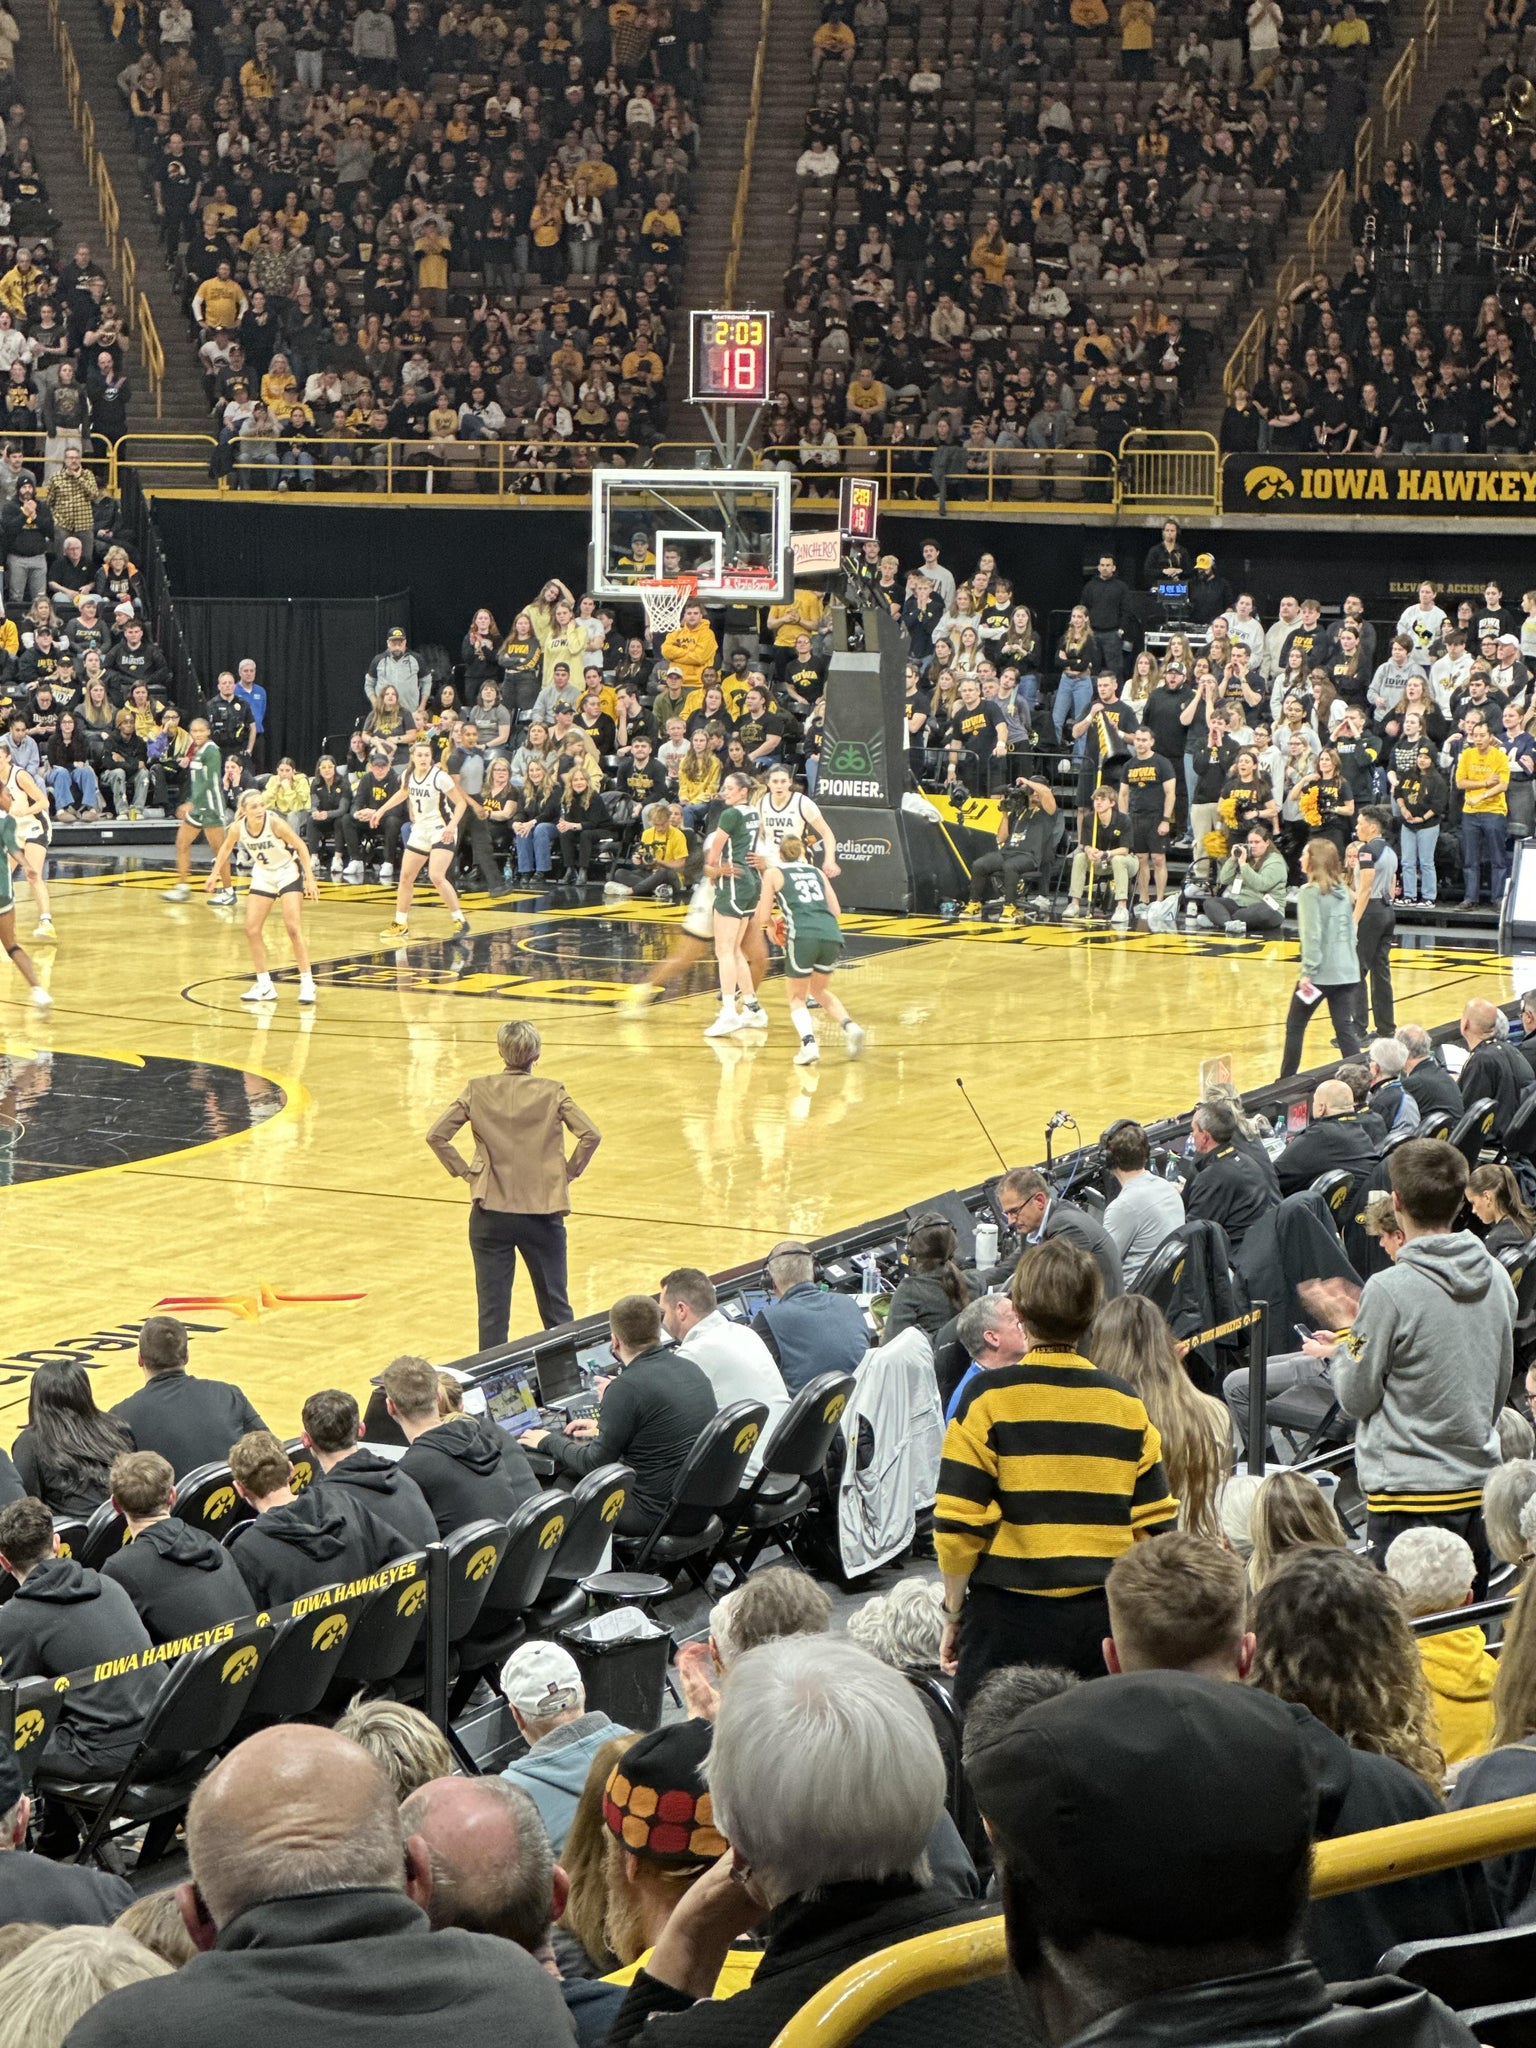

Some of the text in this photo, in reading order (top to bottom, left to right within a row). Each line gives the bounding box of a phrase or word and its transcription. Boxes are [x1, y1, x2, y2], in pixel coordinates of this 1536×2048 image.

[715, 321, 763, 345] 2:03
[723, 347, 755, 390] 18
[1301, 468, 1389, 500] IOWA
[793, 541, 838, 562] PANCHEROS
[1447, 583, 1487, 594] ACCESS
[415, 799, 423, 813] 1
[766, 817, 794, 828] IOWA
[256, 852, 269, 865] 4
[838, 853, 873, 862] COURT
[794, 880, 825, 903] 33
[292, 1560, 417, 1617] IOWA HAWKEYES
[93, 1622, 235, 1682] IOWA HAWKEYES
